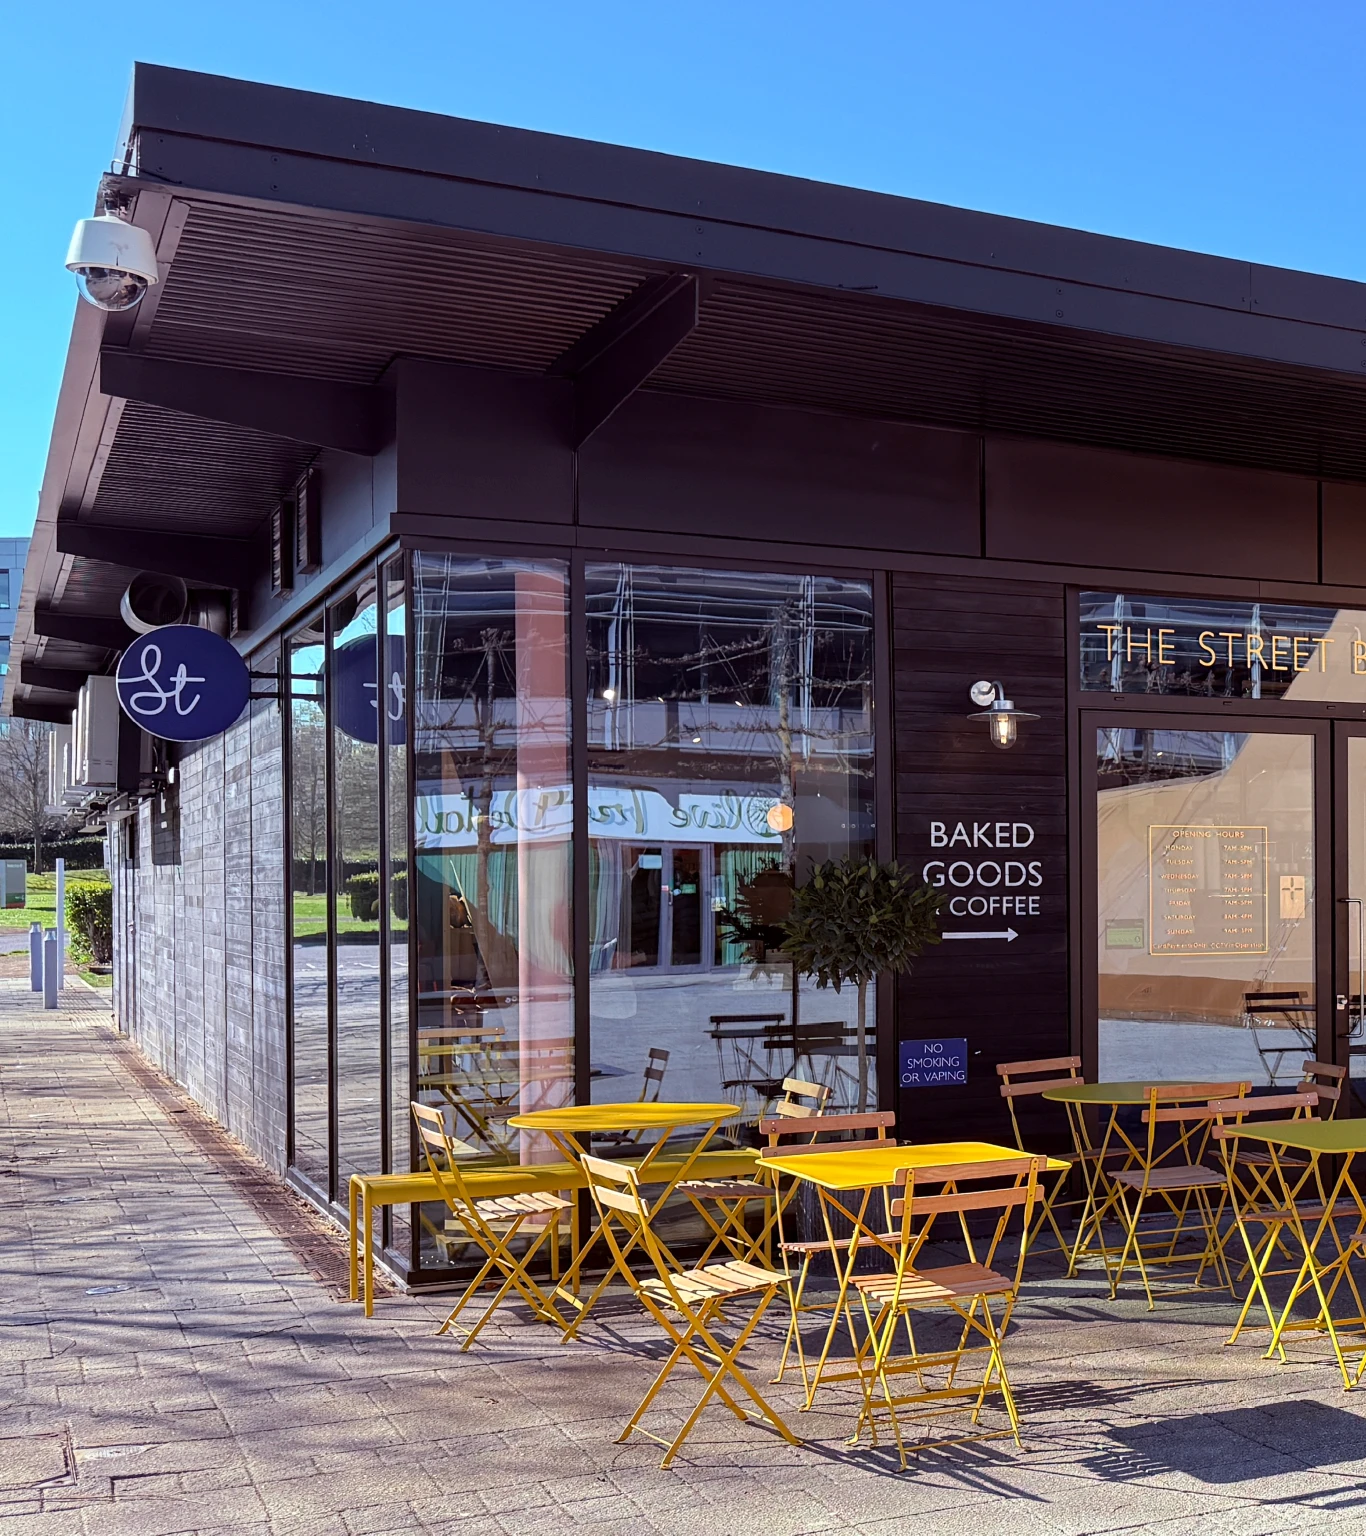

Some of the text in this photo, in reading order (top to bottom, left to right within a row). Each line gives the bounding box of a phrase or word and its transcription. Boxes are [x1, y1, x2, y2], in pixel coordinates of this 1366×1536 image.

[1097, 624, 1175, 665] THE
[1198, 630, 1335, 673] STREET
[118, 644, 206, 716] St
[930, 821, 1035, 848] BAKED
[1172, 830, 1211, 838] OPENING
[922, 861, 1043, 887] GOODS
[949, 896, 1041, 916] COFFEE
[924, 1043, 943, 1053] NO
[907, 1056, 960, 1069] SMOKING
[902, 1070, 965, 1083] OR VAPING
